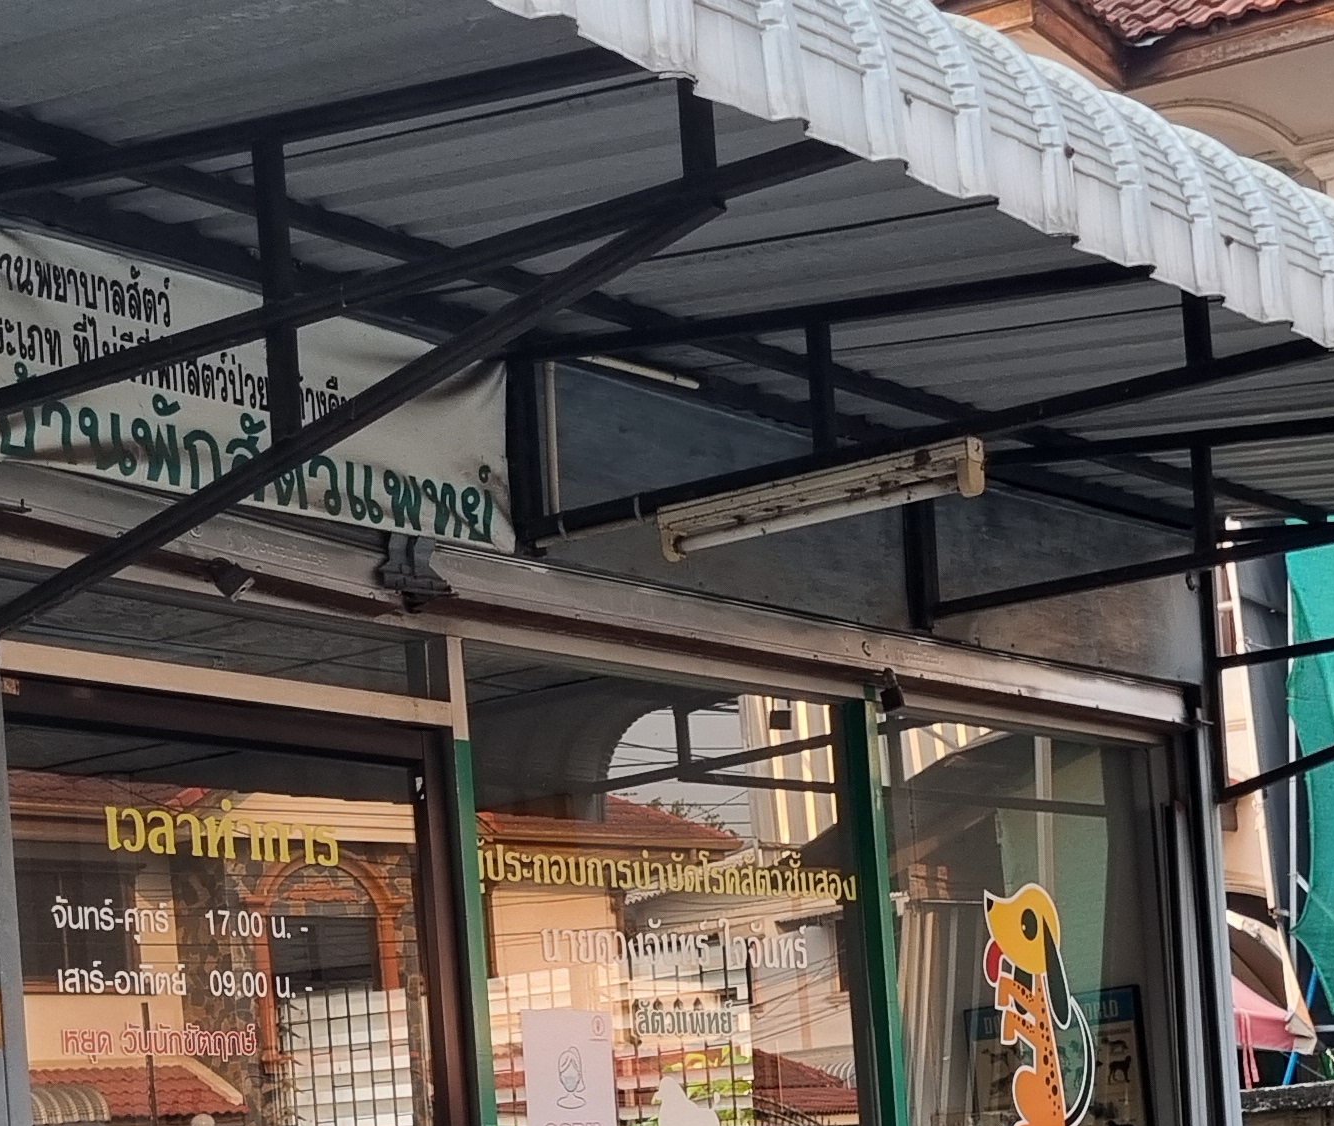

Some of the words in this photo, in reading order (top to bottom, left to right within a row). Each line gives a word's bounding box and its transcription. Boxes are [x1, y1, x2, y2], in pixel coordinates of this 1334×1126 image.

[105, 799, 340, 866] เวลาทำการ
[51, 896, 169, 943] จันทร์-ศุกร์
[204, 909, 263, 939] 17.00
[270, 914, 292, 940] น.
[57, 960, 187, 996] เสาร์-อาทิตย์
[209, 970, 269, 998] 09.00
[275, 974, 298, 998] น.
[636, 1000, 734, 1036] สัตวแพทย์
[62, 1028, 114, 1064] หยุด
[122, 1022, 257, 1062] วันนักขัตฤกษ์
